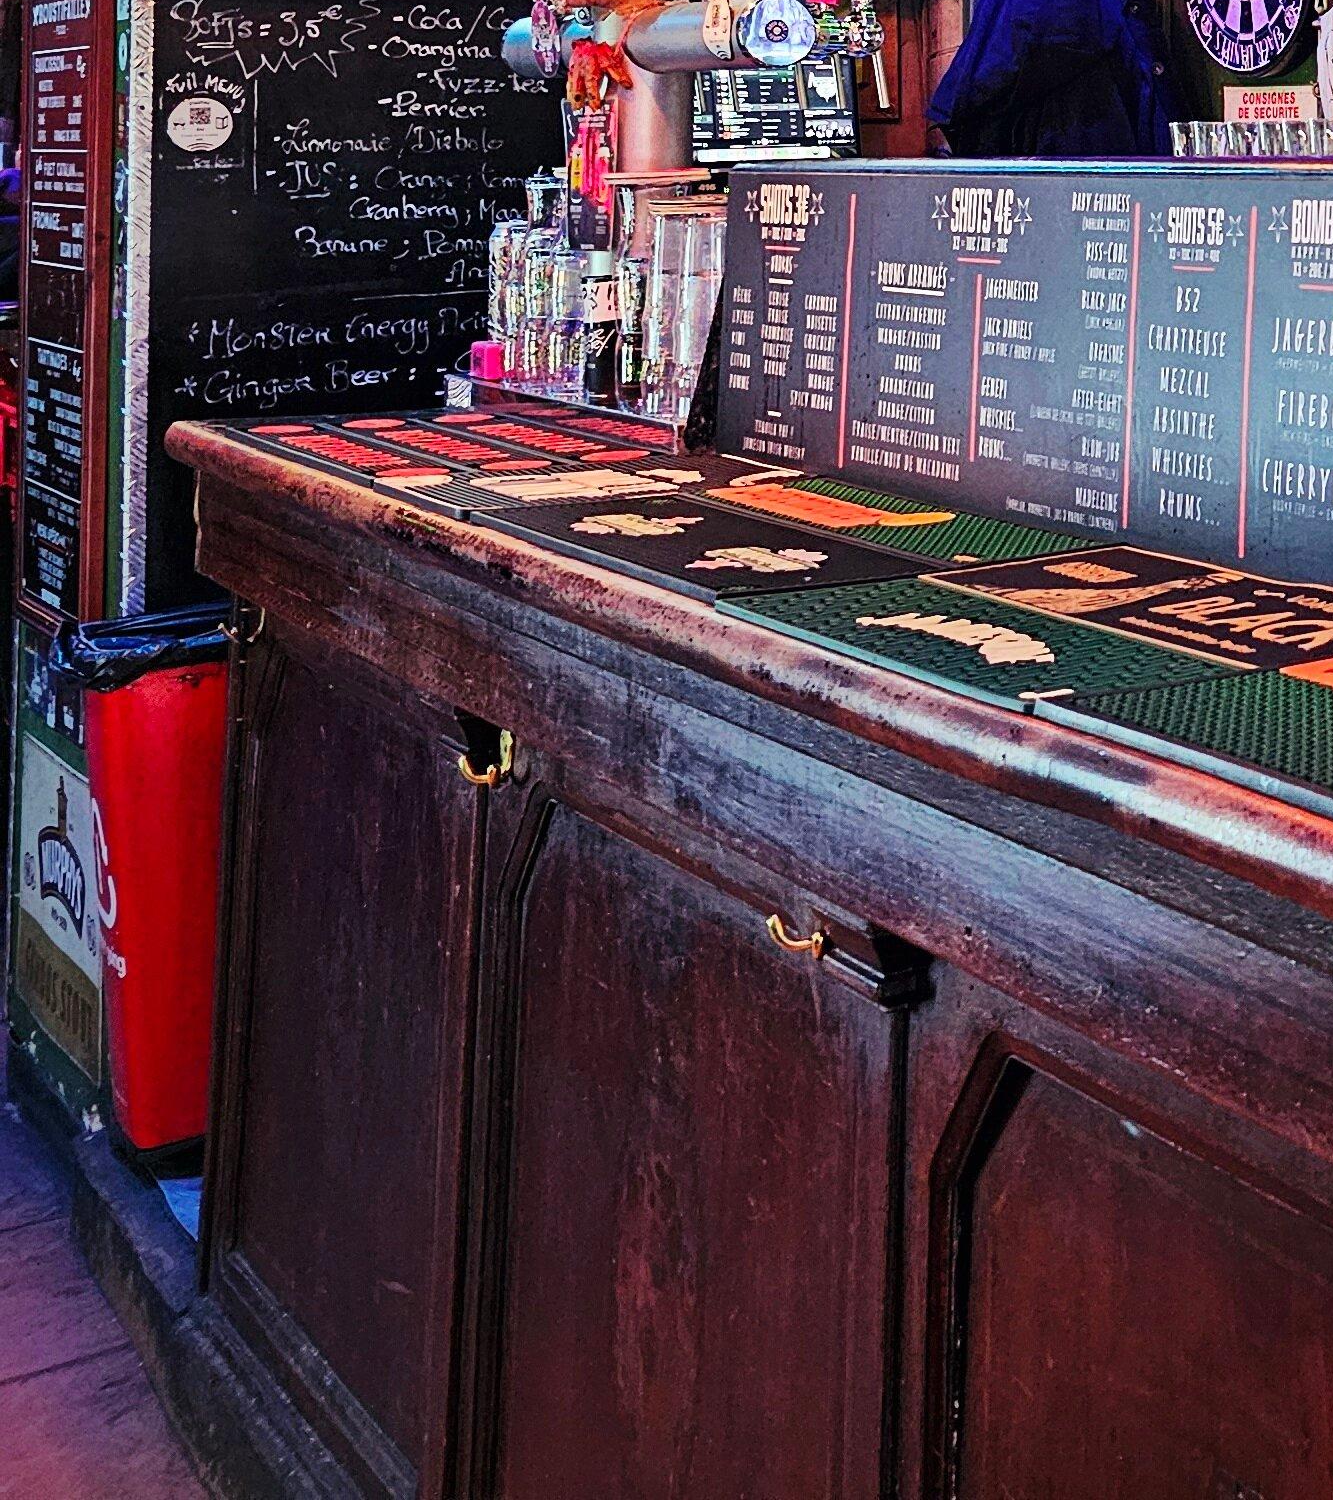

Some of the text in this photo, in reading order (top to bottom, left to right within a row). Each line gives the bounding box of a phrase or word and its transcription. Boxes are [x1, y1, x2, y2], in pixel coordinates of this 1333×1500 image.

[382, 37, 492, 60] Orangina
[1239, 105, 1299, 119] DE SECURITE
[1243, 92, 1295, 106] CONSIGNES
[760, 185, 793, 224] SHOTS
[951, 188, 1013, 234] SHOTS 4€
[1167, 206, 1206, 245] SHOTS
[1207, 207, 1225, 245] 5€
[1176, 286, 1200, 313] B52
[1088, 342, 1125, 364] ORGASME
[1148, 324, 1226, 358] CHARTREUSE
[326, 361, 391, 393] Beer
[1160, 366, 1210, 399] MEZCAL
[1072, 389, 1122, 413] AFTER-EIGHT
[1153, 407, 1215, 440] ABSINTHE
[1075, 487, 1118, 513] MADELEINE
